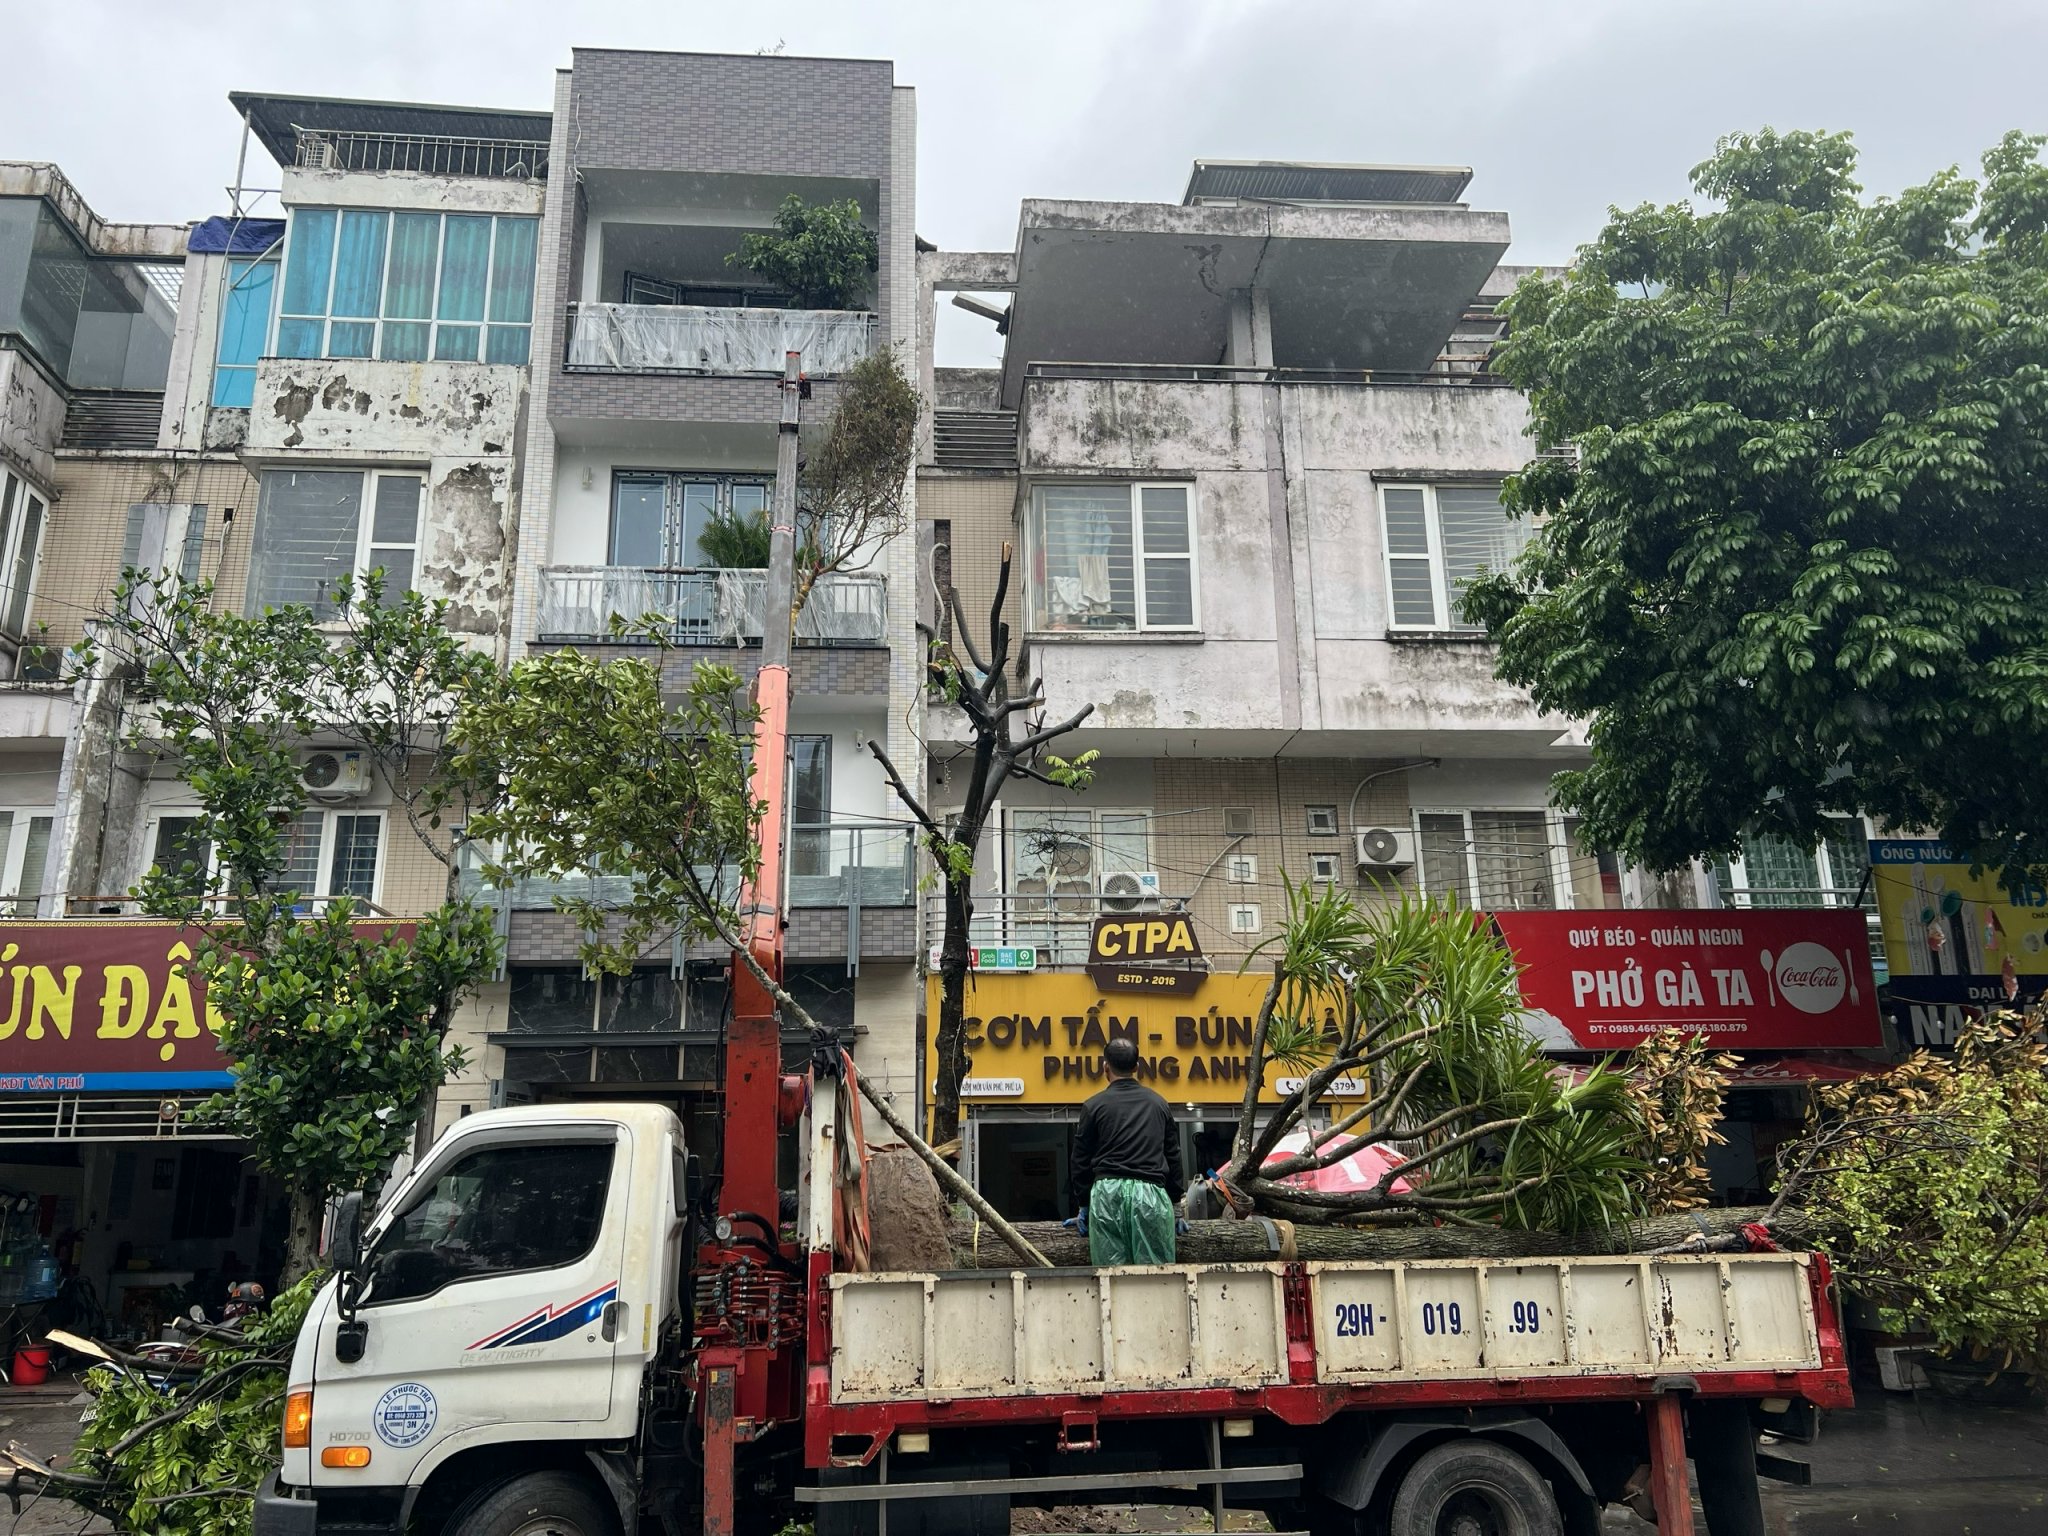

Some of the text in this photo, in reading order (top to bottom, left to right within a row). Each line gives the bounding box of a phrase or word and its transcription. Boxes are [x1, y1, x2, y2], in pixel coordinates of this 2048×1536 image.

[1097, 920, 1194, 957] CTPA
[1569, 926, 1599, 948] QUÝ
[1604, 926, 1636, 947] BÉO
[1651, 925, 1695, 948] QUÁN
[1698, 928, 1744, 946] NGON
[1117, 974, 1176, 986] ESTD 2016
[1571, 957, 1755, 1008] PHỞ GÀ TA
[963, 1013, 1052, 1047] CƠM
[1061, 1000, 1139, 1047] TẤM
[1175, 1006, 1253, 1047] BÚN
[1589, 1024, 1608, 1035] ĐT:
[1188, 1056, 1252, 1080] ANH
[28, 1074, 55, 1090] VĂN
[57, 1073, 85, 1090] PHÚ
[1422, 1302, 1462, 1336] 019
